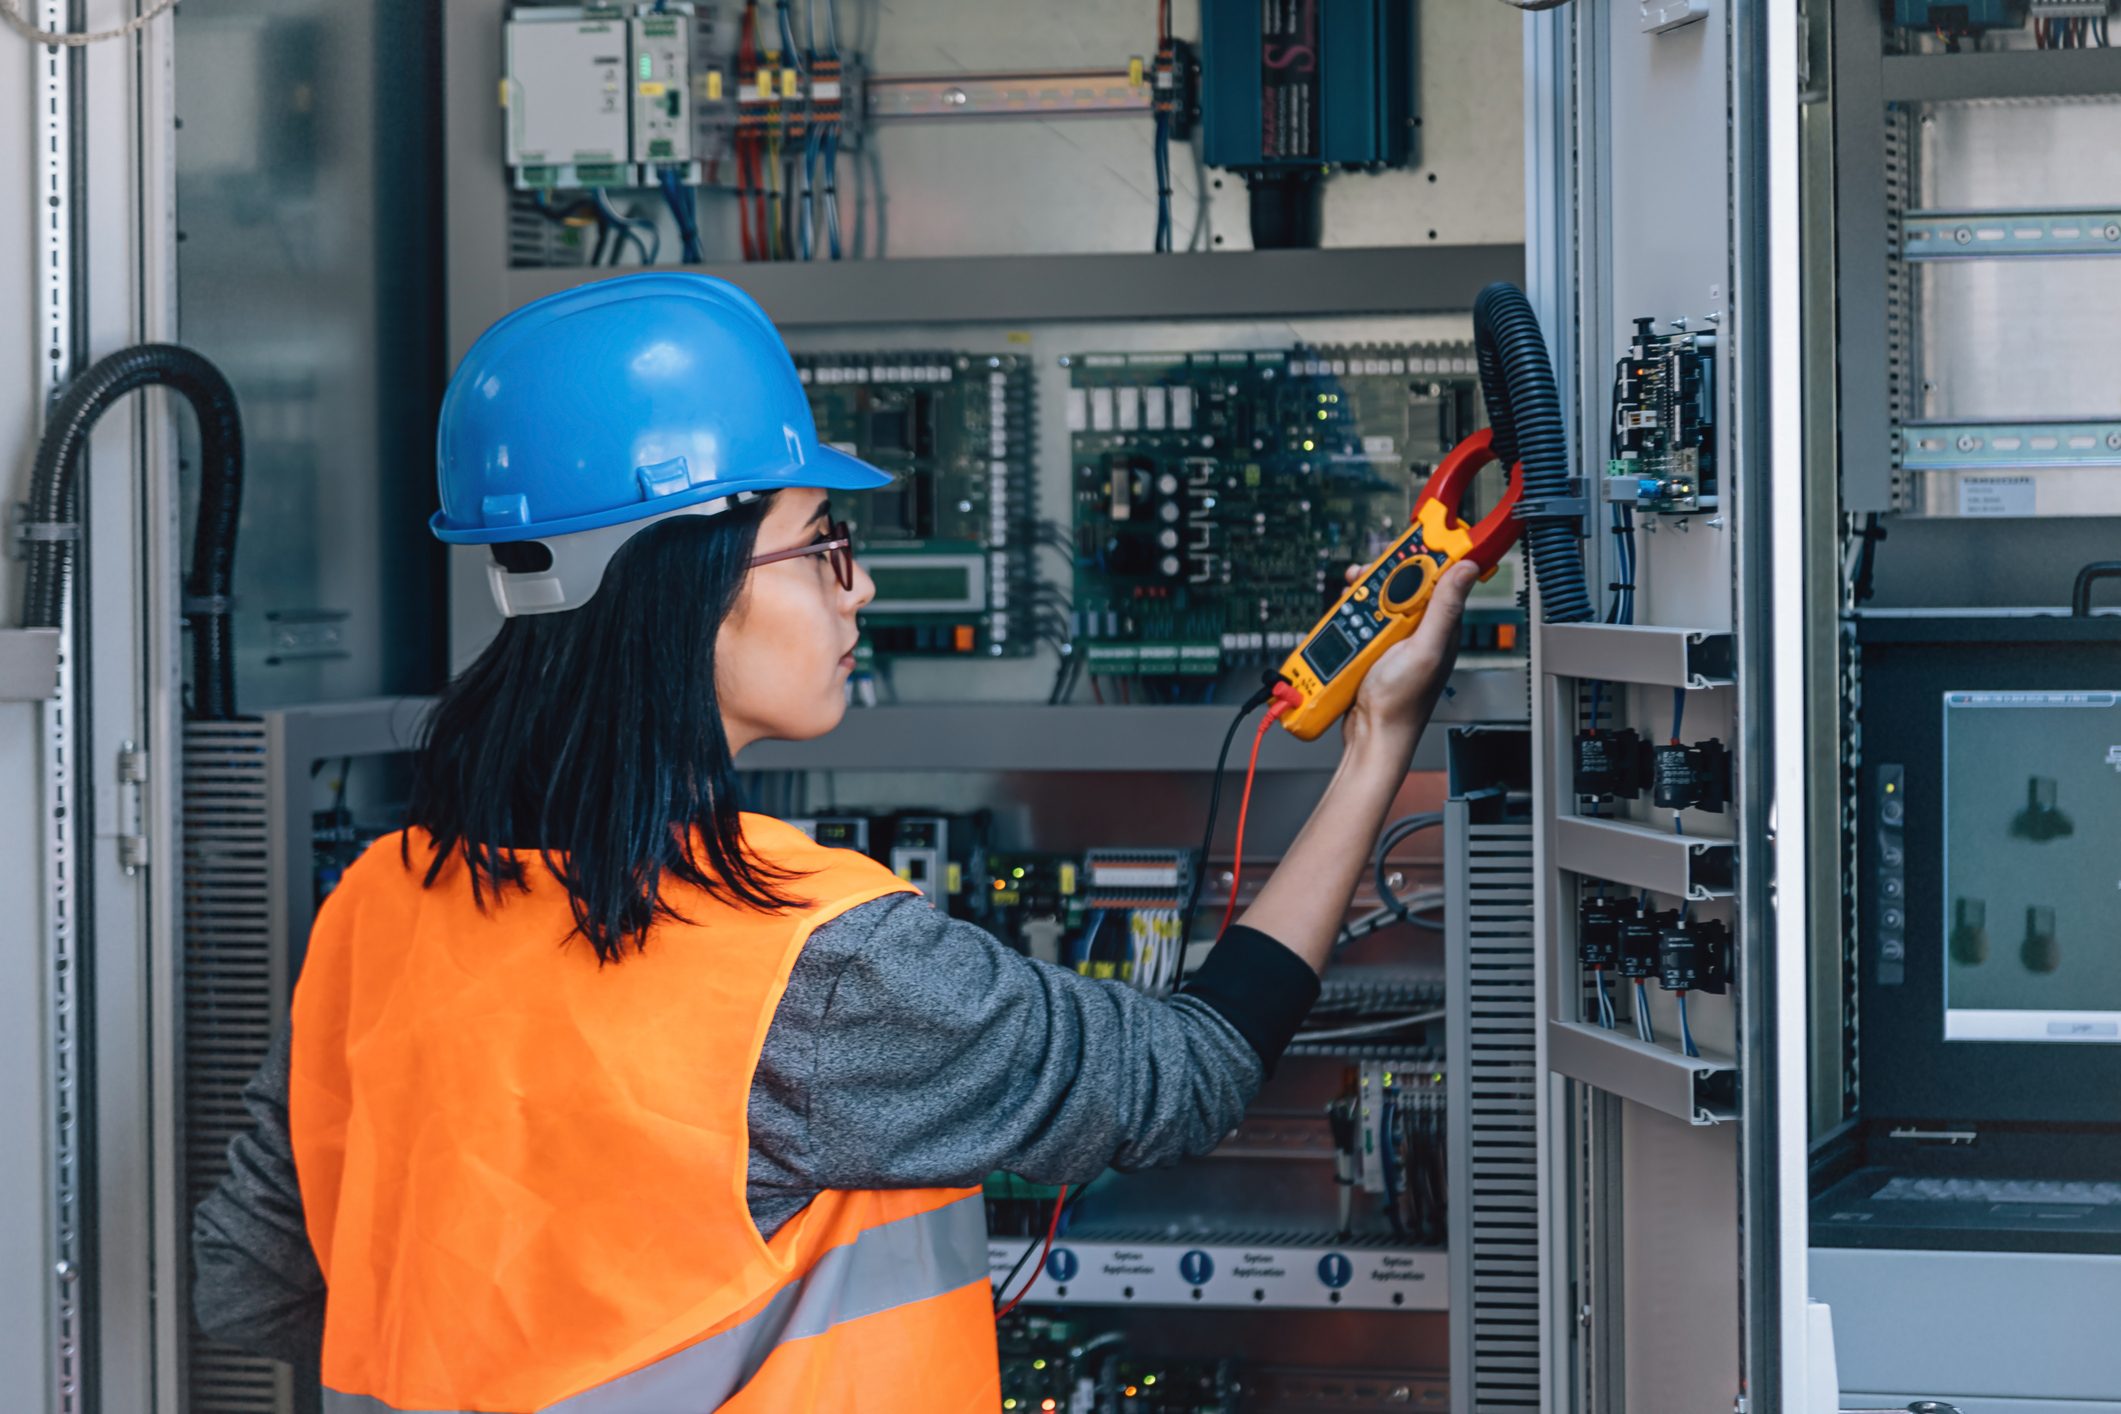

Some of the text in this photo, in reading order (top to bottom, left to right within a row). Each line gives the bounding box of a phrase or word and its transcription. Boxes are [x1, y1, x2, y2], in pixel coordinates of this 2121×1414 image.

[1113, 1251, 1143, 1262] Option
[1243, 1253, 1274, 1264] Option
[1382, 1256, 1413, 1268] Option
[1103, 1264, 1154, 1276] Application
[1233, 1267, 1285, 1278] Application
[1371, 1270, 1425, 1282] Application
